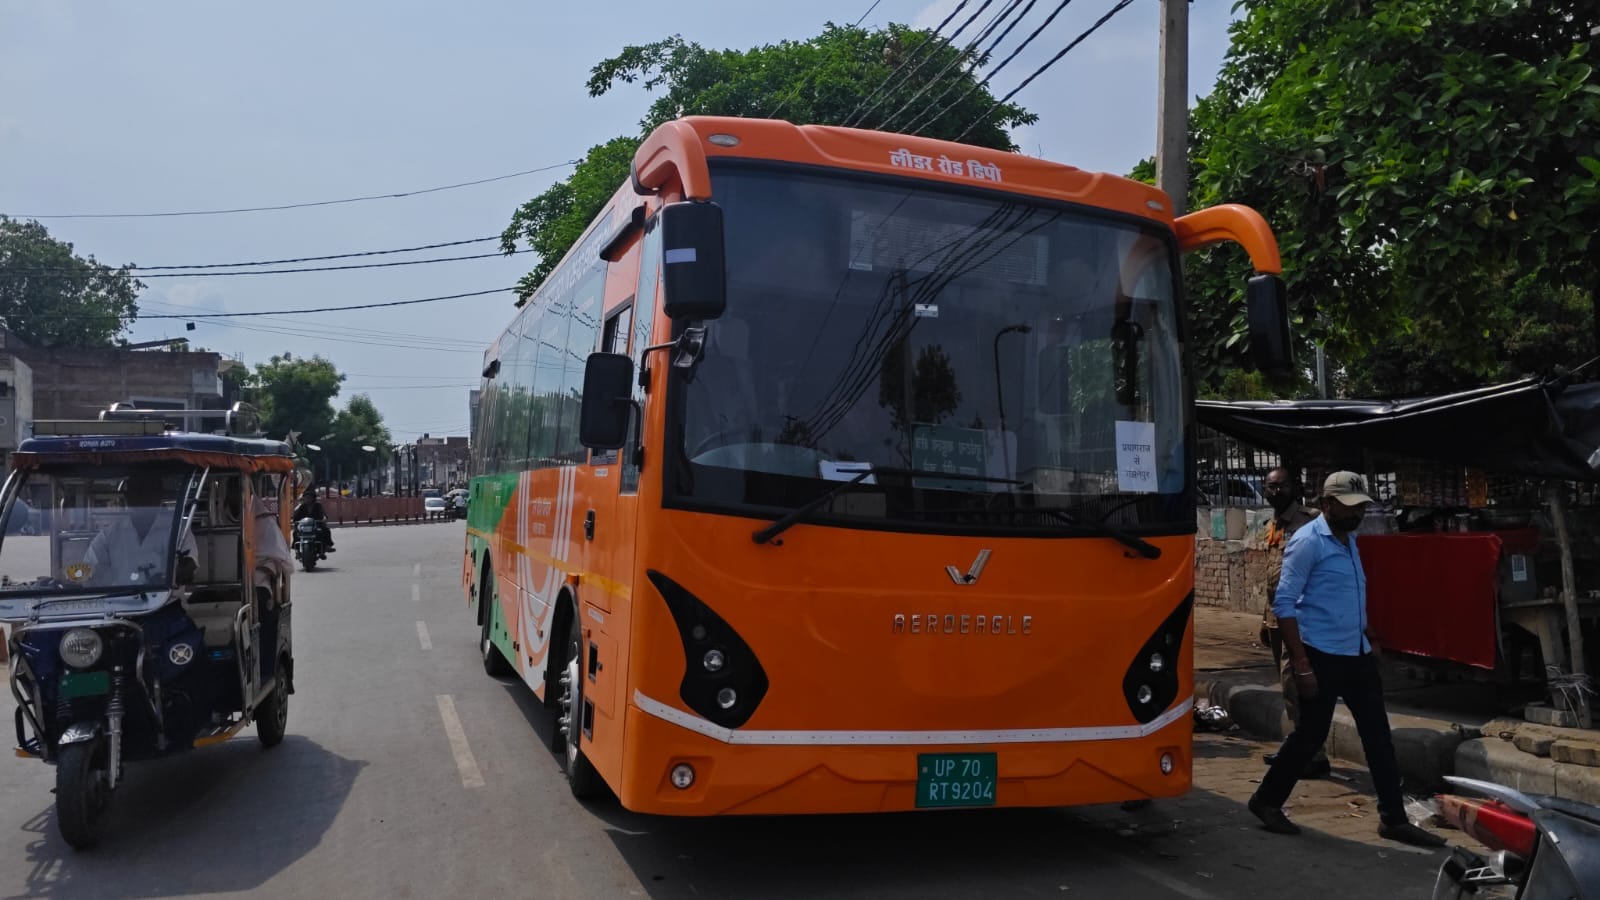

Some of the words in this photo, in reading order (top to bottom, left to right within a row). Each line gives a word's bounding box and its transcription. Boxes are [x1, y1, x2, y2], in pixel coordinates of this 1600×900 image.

[889, 148, 933, 171] लीडर
[936, 154, 963, 176] रोड
[966, 159, 1002, 182] डिपो
[1122, 442, 1151, 453] प्रयागराज
[893, 613, 1033, 635] AEROEAGLE
[935, 759, 956, 777] UP
[961, 759, 981, 777] 70
[929, 781, 993, 801] RT9204
